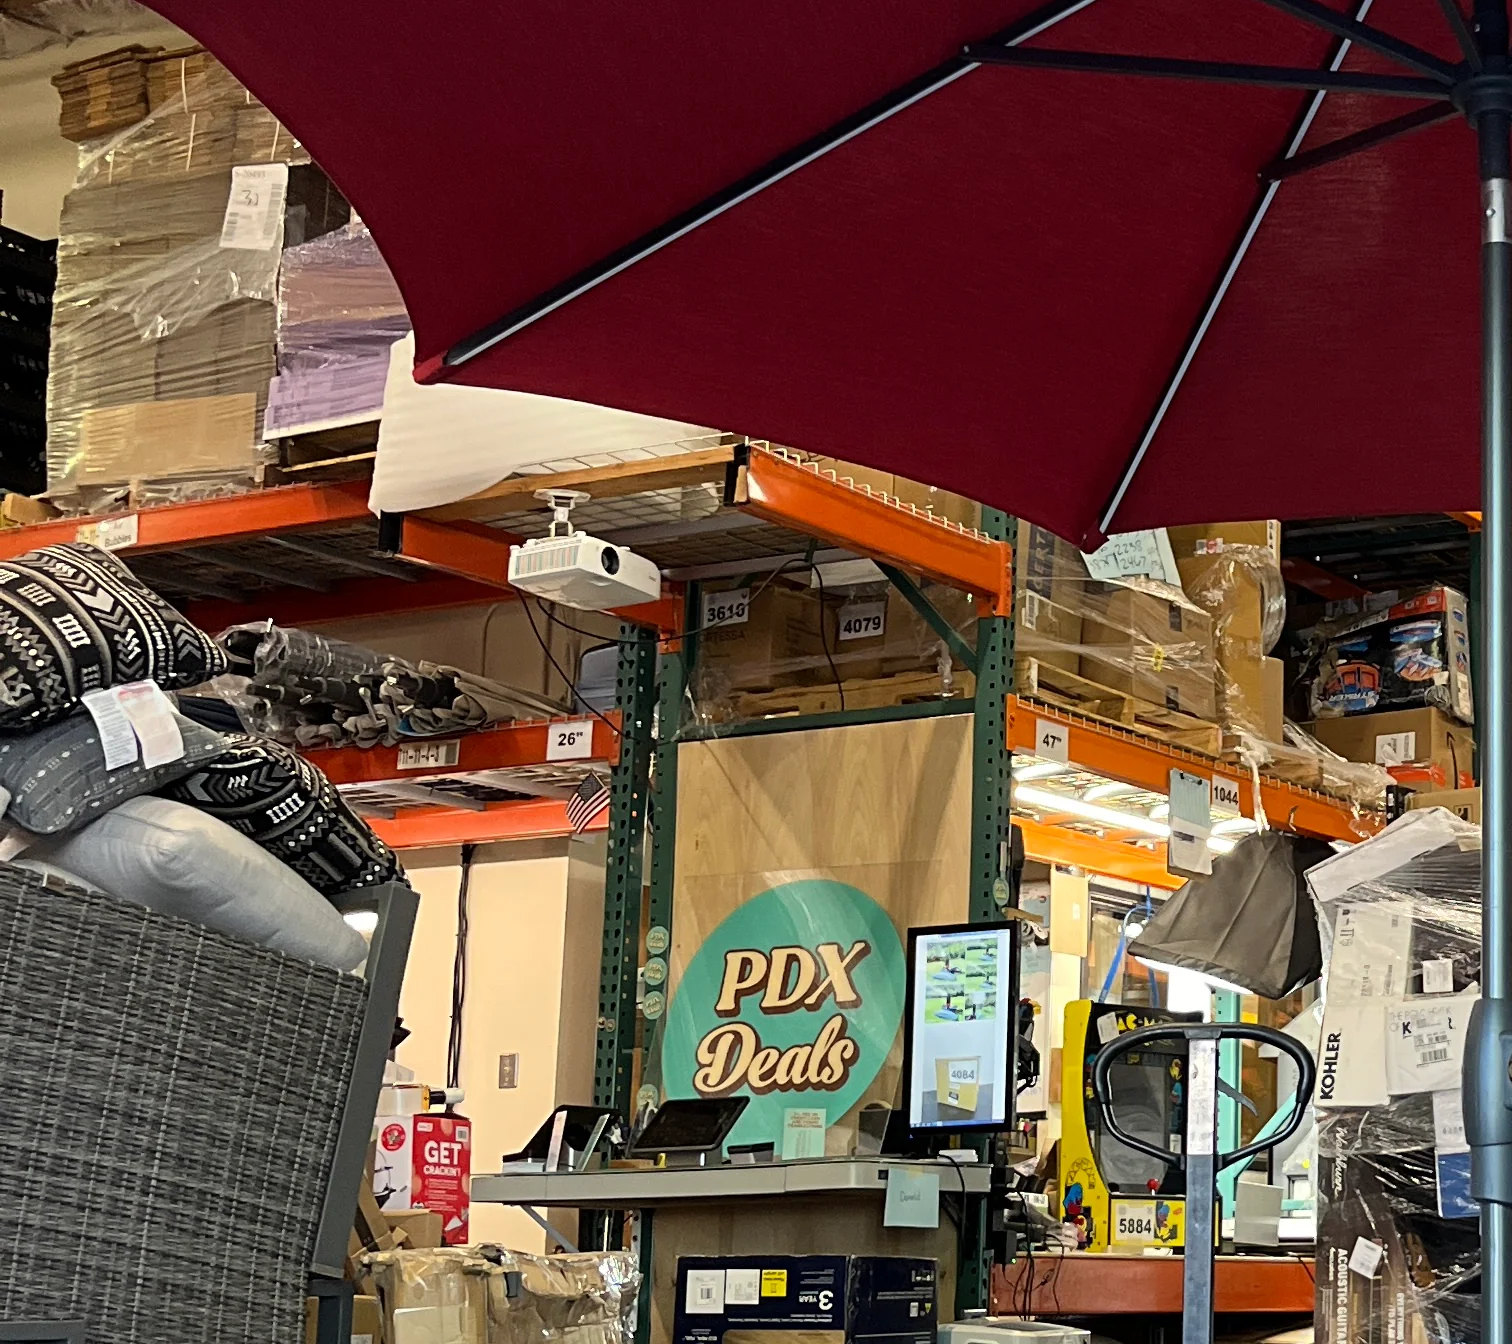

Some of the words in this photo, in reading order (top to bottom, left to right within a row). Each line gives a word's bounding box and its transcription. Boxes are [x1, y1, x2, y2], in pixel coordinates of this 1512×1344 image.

[843, 616, 881, 634] 4079
[1213, 785, 1239, 805] 1044
[714, 940, 871, 1018] PDX
[693, 1013, 860, 1098] Deals
[1320, 1032, 1341, 1100] KOHLER
[951, 1068, 976, 1080] 4084
[424, 1140, 462, 1165] GET
[1119, 1218, 1152, 1234] 5884
[1336, 1248, 1348, 1304] ACOUSTIC
[818, 1289, 834, 1311] 3
